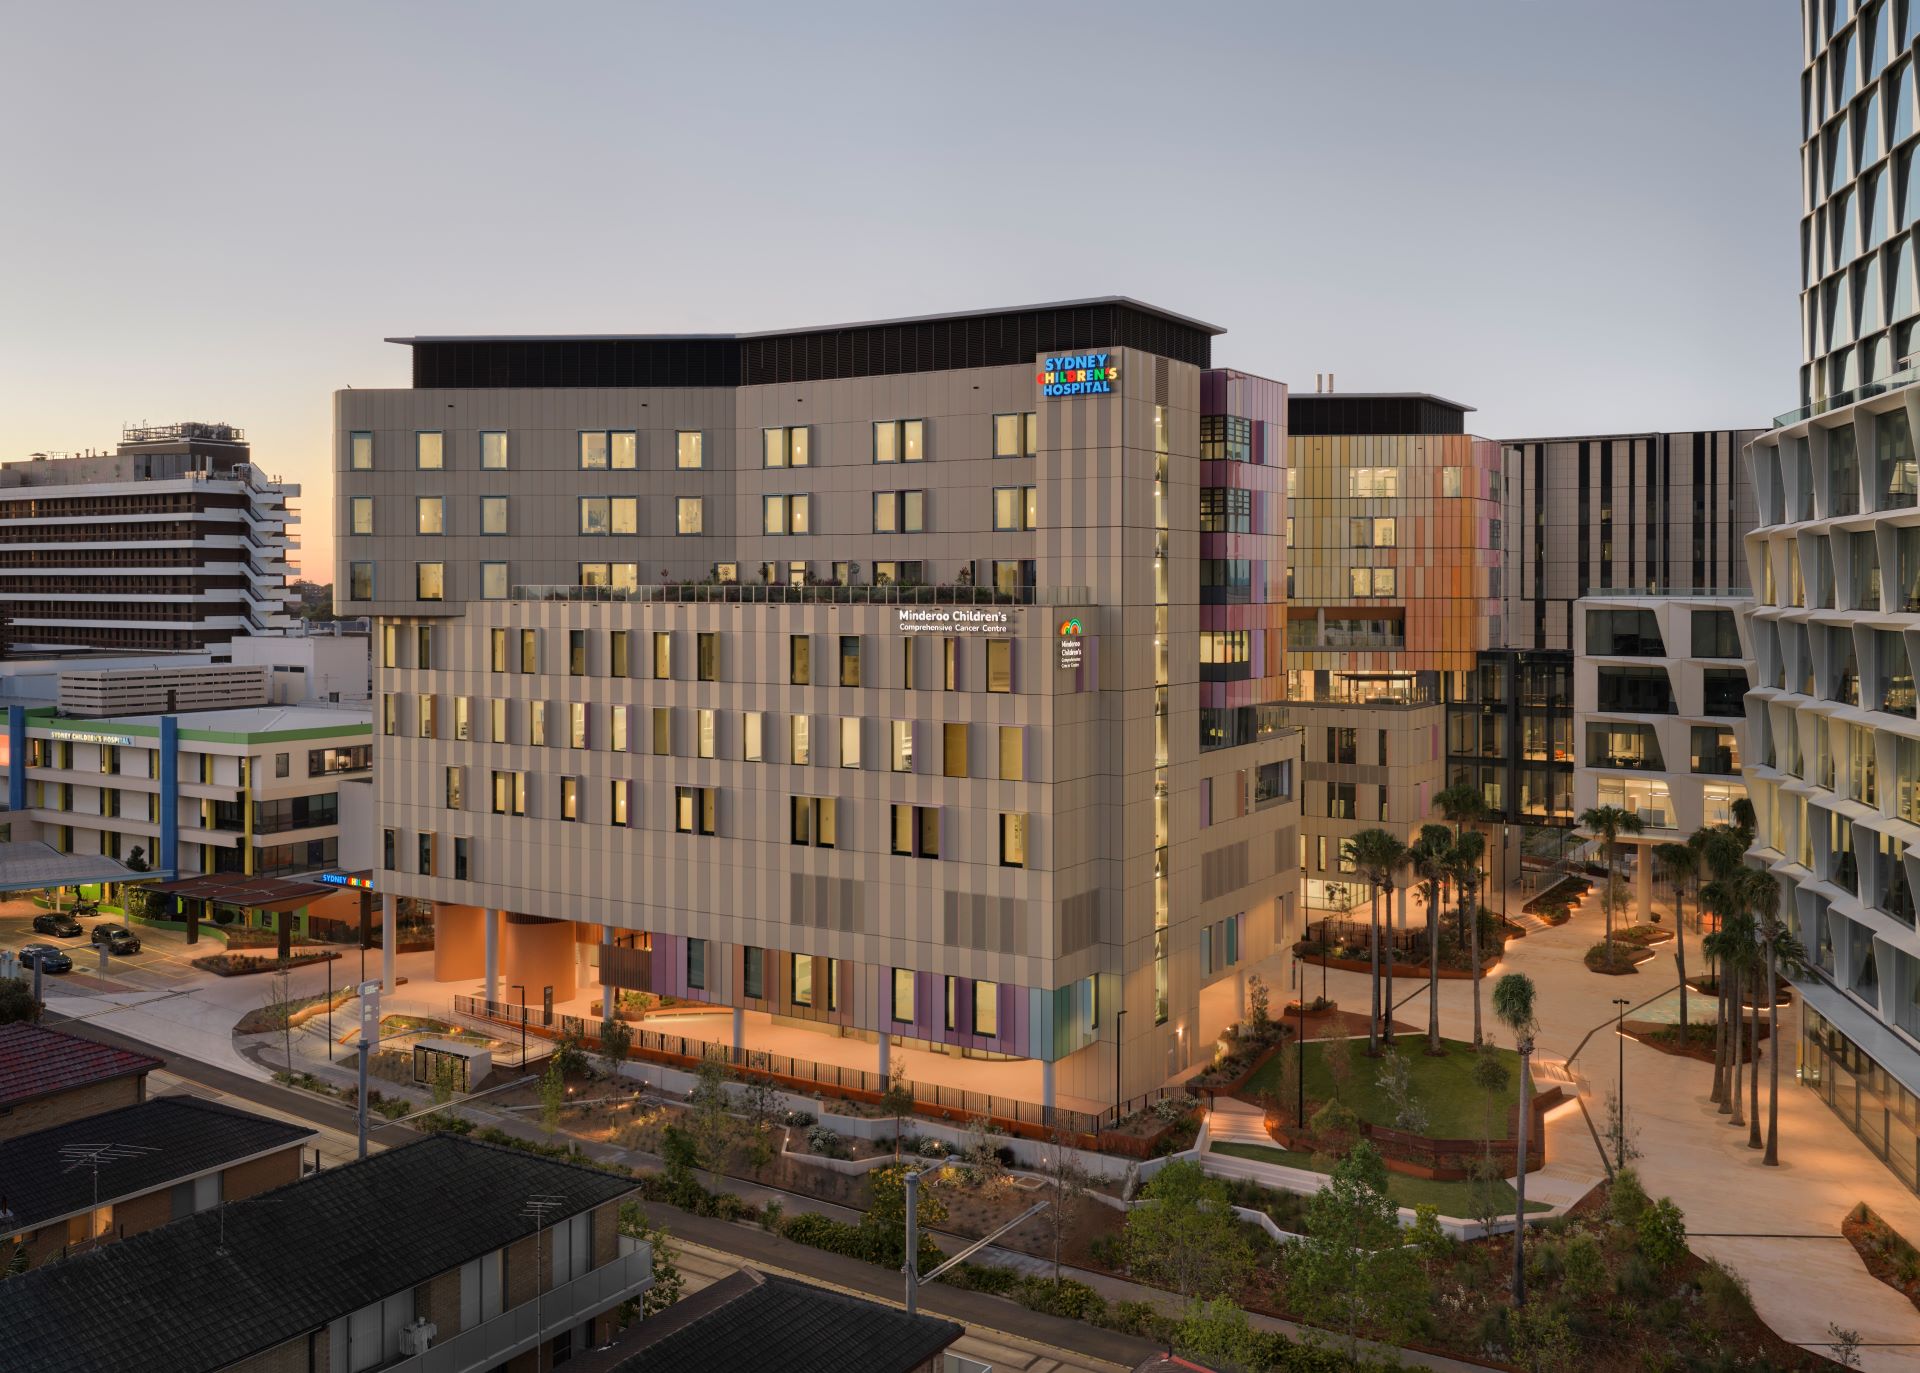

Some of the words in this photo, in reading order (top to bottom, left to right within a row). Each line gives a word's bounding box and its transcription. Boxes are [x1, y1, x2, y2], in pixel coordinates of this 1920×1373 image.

[1045, 354, 1107, 371] SYDNEY
[1036, 367, 1117, 384] CHILDREN'S
[1043, 380, 1110, 396] HOSPITAL
[899, 610, 950, 621] Minderoo
[952, 610, 1007, 622] Children's
[899, 623, 952, 632] Comprehensive
[955, 623, 980, 632] Cancer
[982, 624, 1007, 632] Centre
[51, 731, 71, 740] SYDNEY
[103, 735, 131, 745] HOSPITAL
[322, 874, 347, 885] SYDNEY
